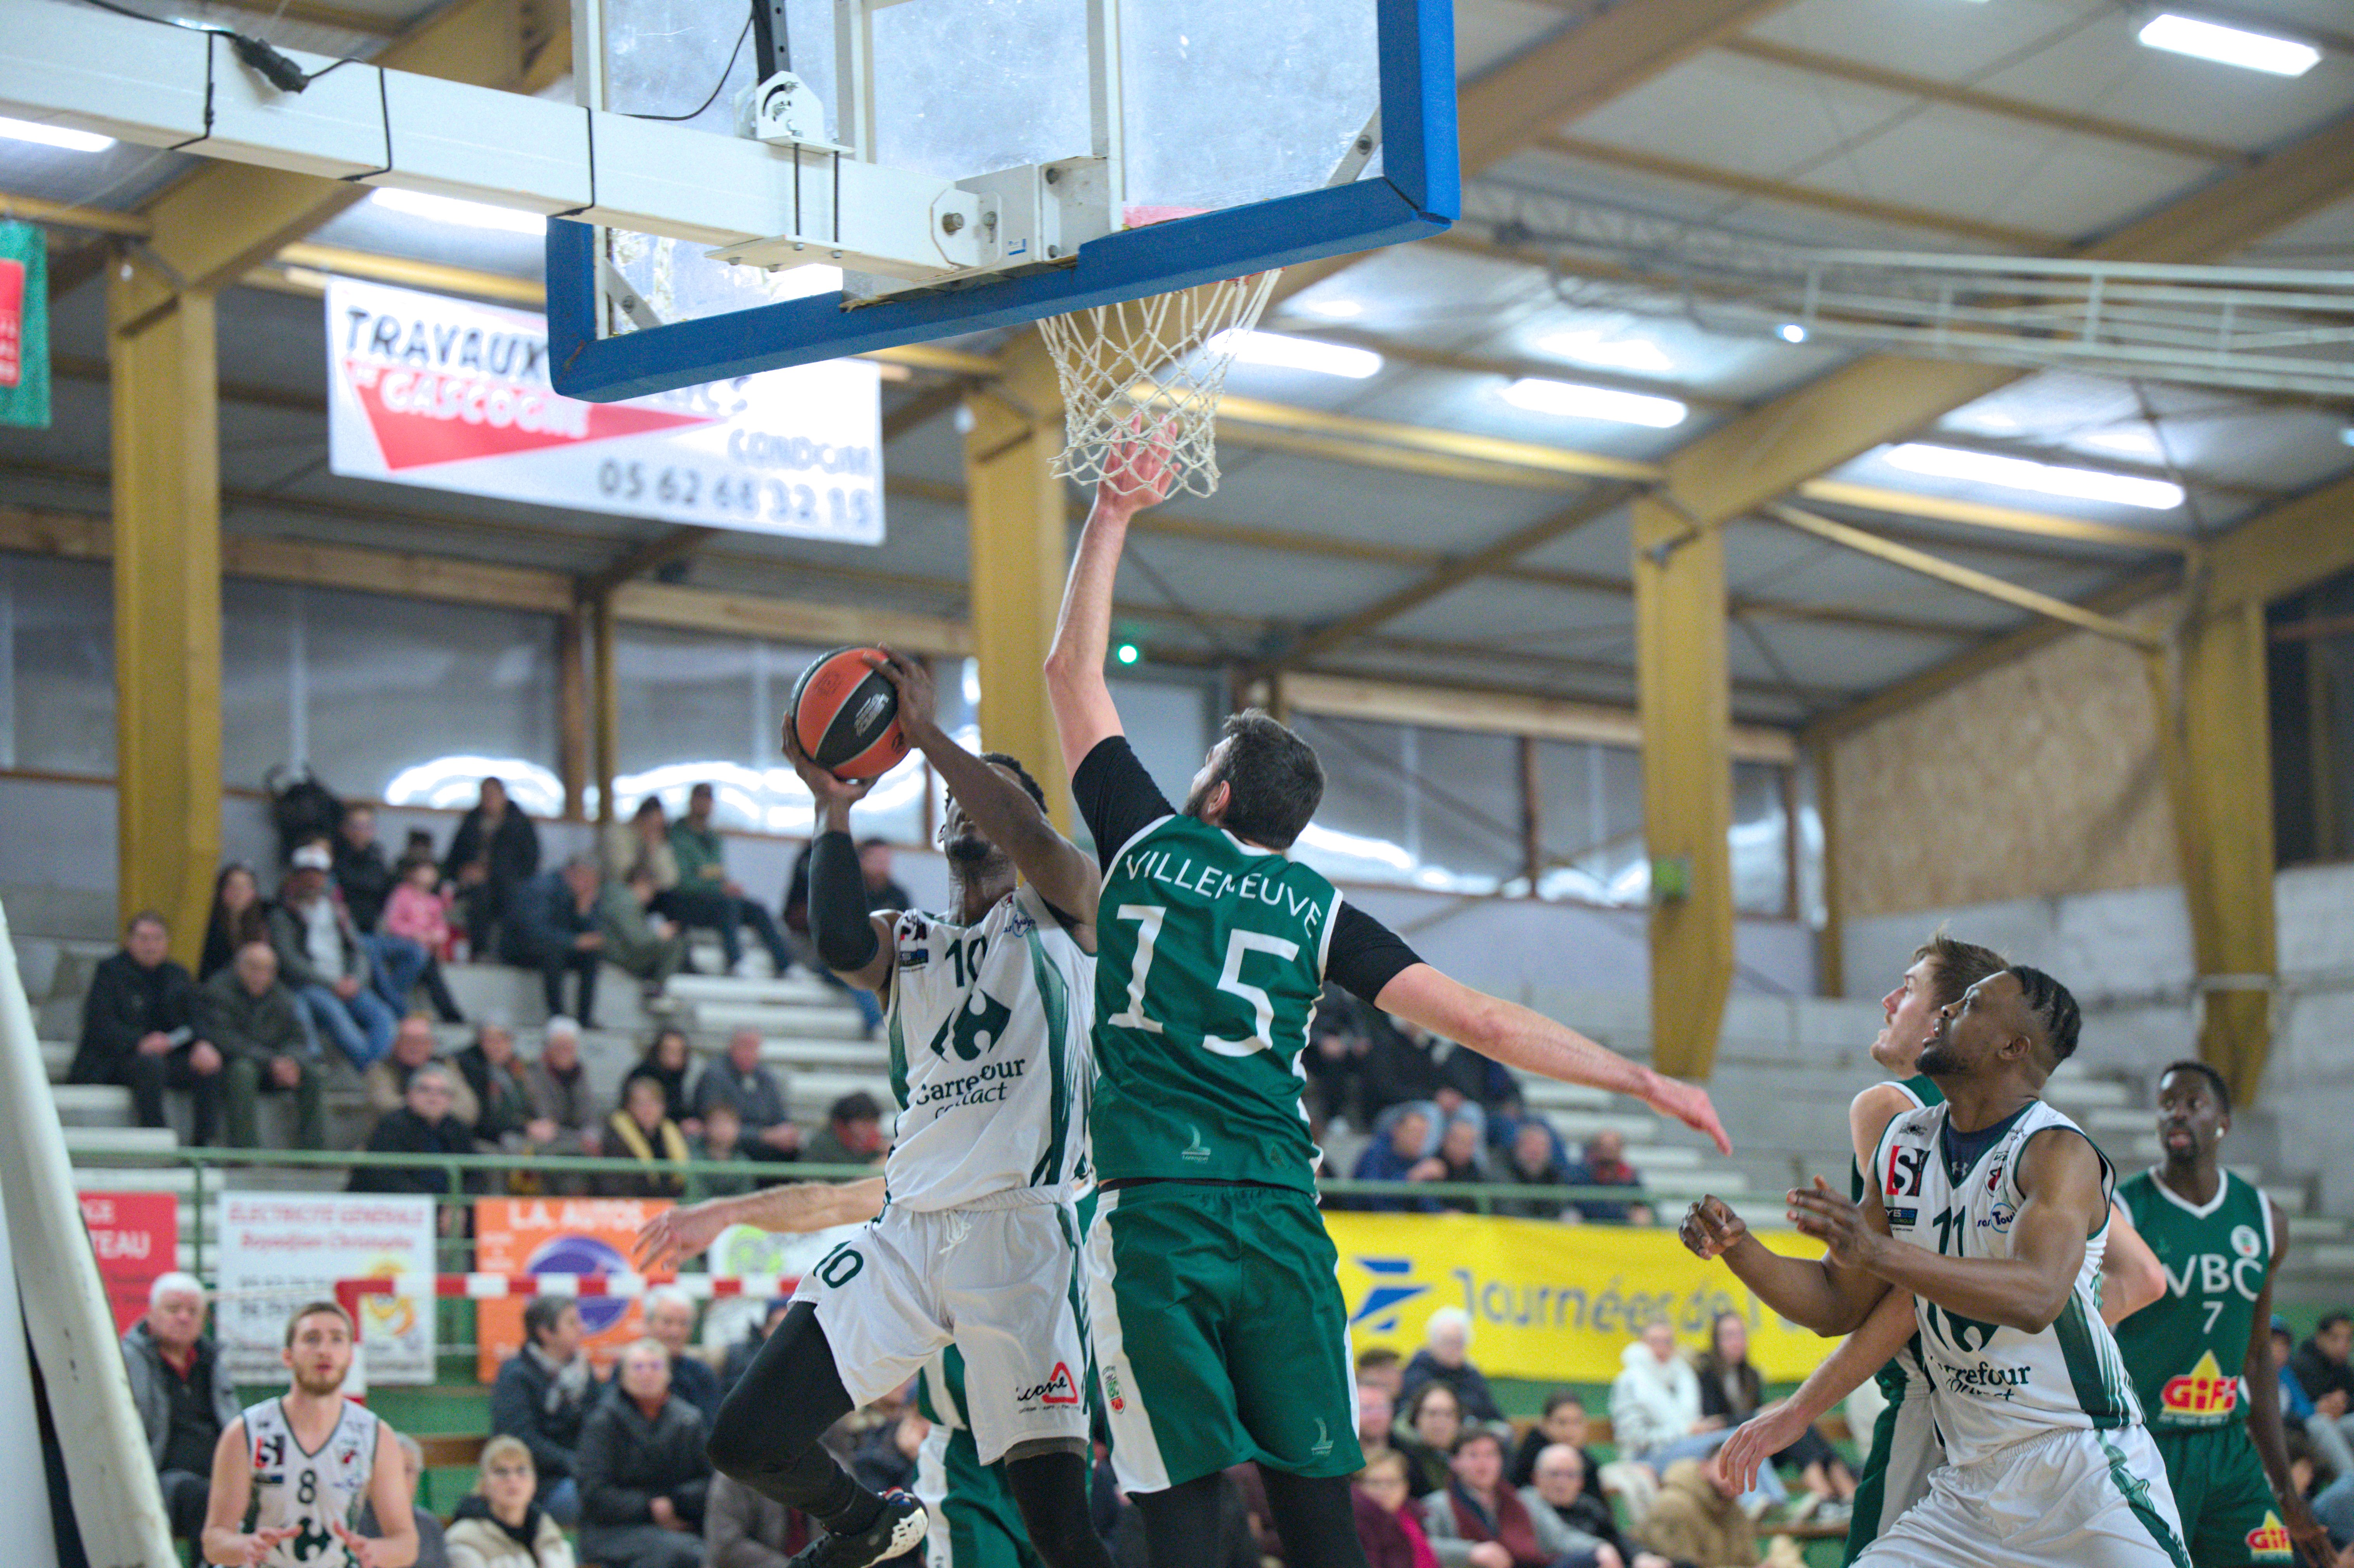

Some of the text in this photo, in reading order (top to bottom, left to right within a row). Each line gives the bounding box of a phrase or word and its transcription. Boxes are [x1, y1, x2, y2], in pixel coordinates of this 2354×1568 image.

[346, 306, 548, 382] TRAVAUX
[598, 457, 644, 501] 05
[945, 936, 989, 988] 10
[1108, 904, 1300, 1057] 15
[916, 1058, 1026, 1105] Carreour
[1933, 1205, 1966, 1257] 11
[813, 1240, 864, 1289] 10
[2161, 1254, 2262, 1302] VBC
[2202, 1301, 2224, 1334] 7
[298, 1469, 316, 1504] 8
[2247, 1529, 2290, 1549] GiF
